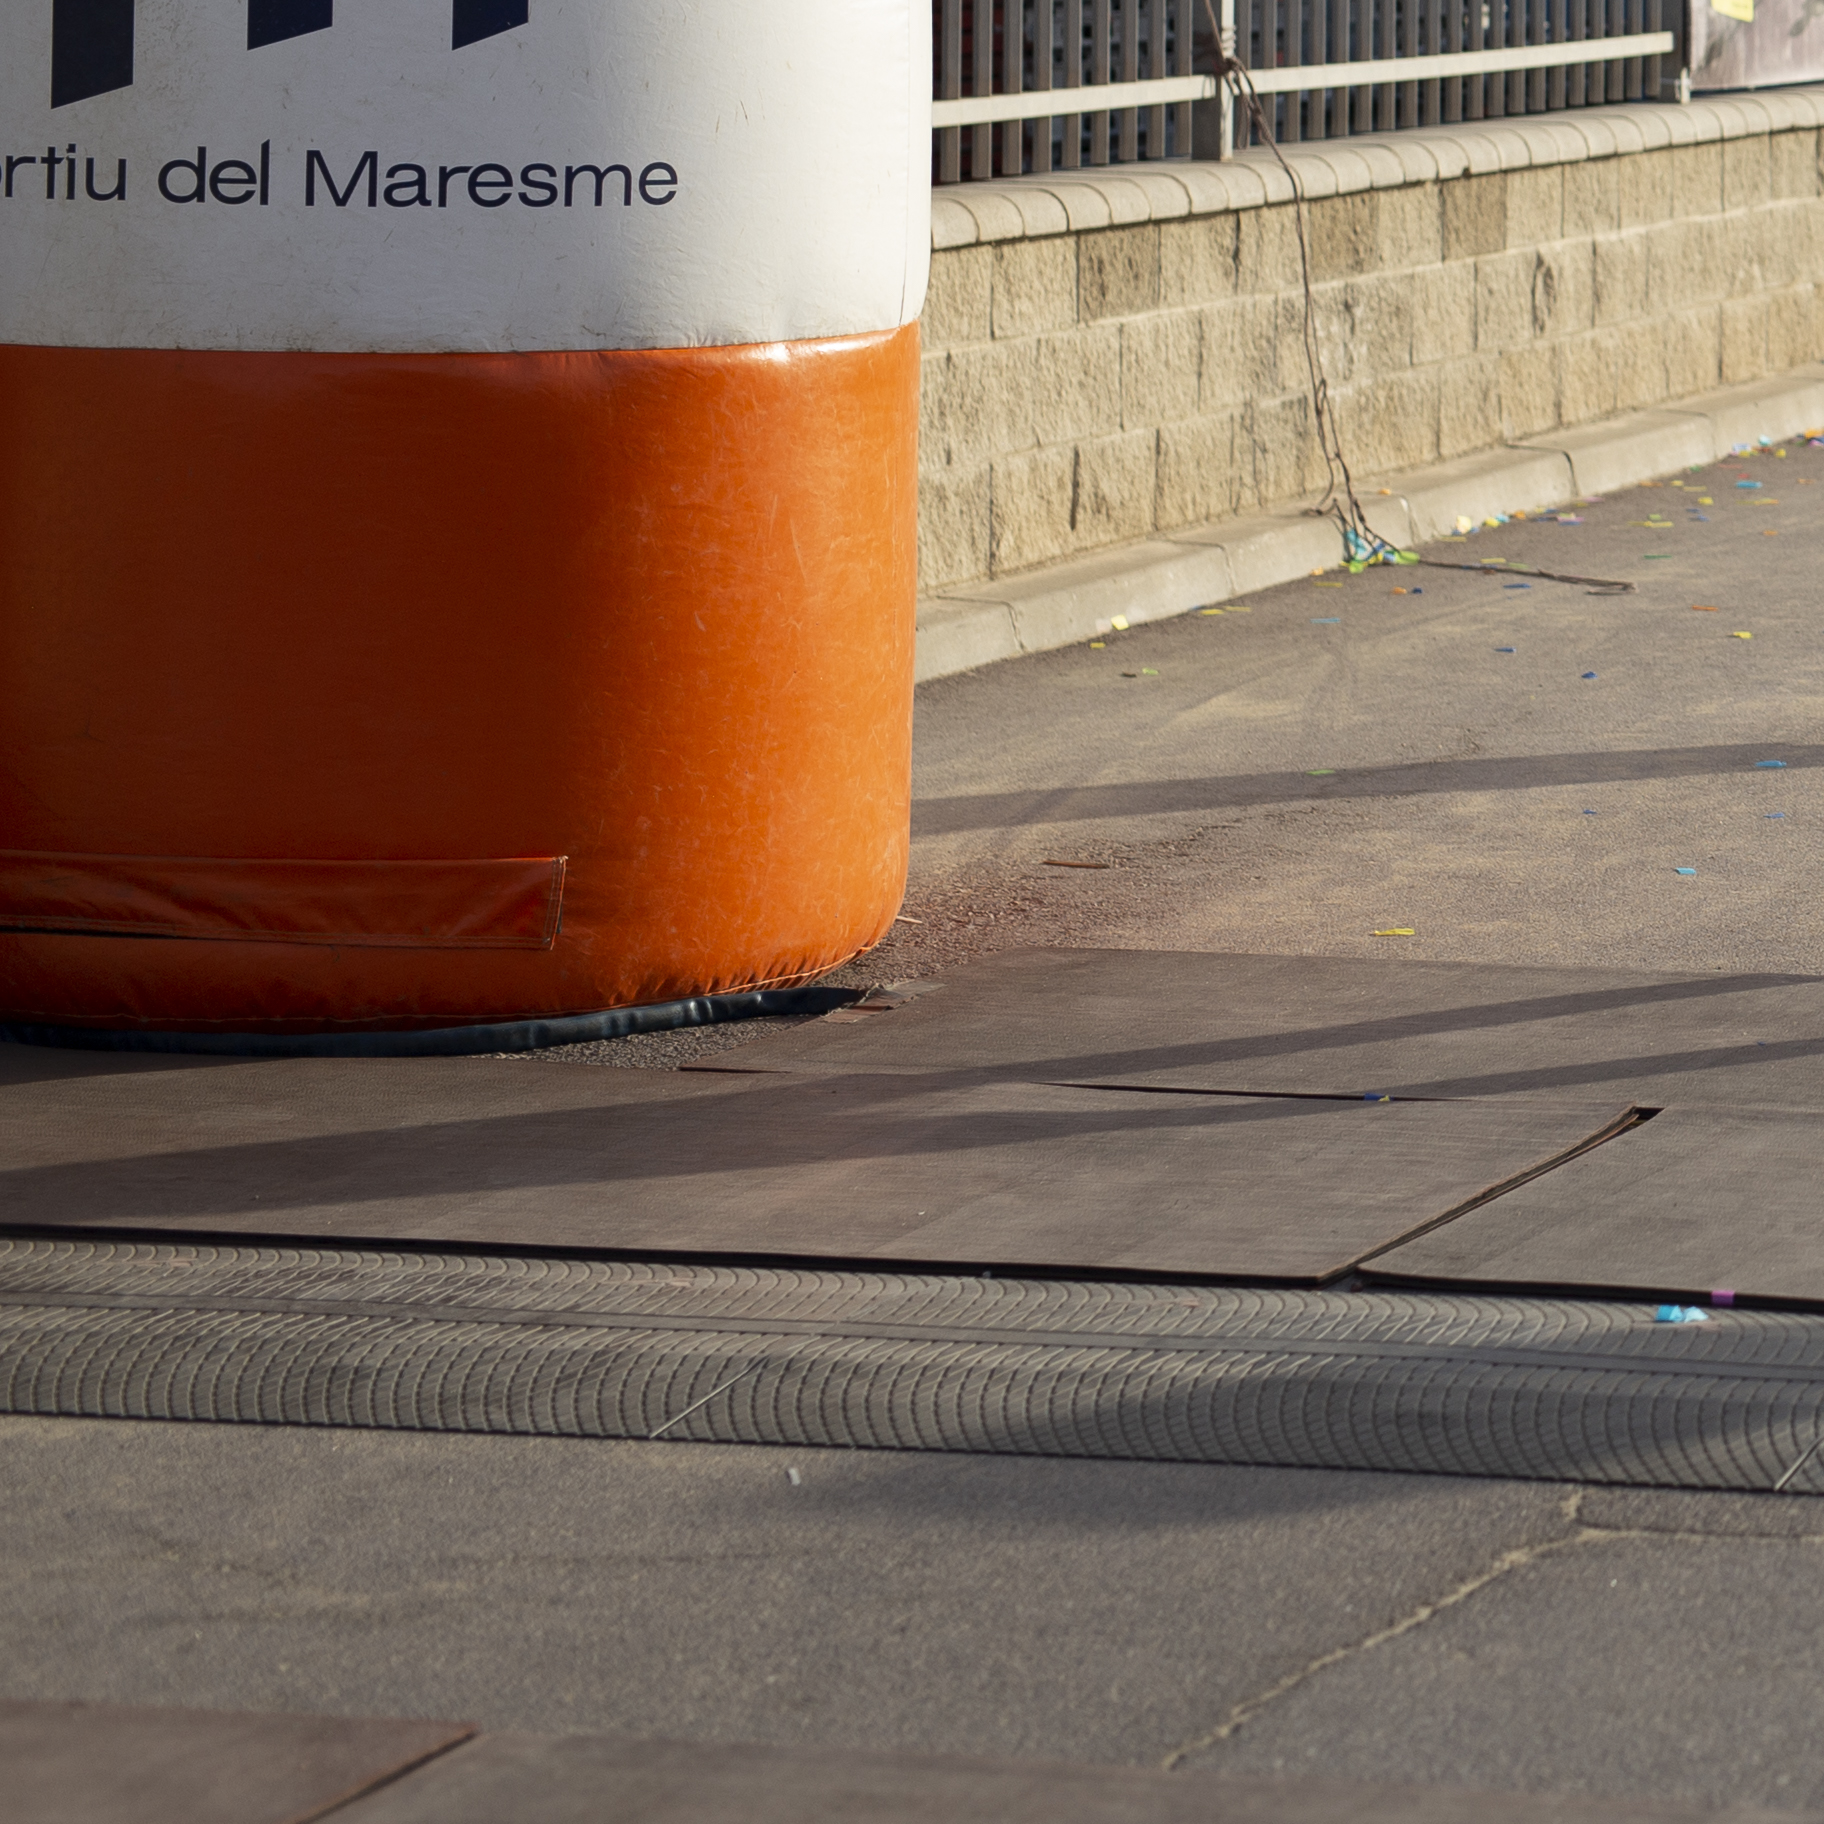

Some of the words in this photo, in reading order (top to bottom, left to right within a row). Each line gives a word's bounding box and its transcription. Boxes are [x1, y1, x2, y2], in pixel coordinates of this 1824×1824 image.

[0, 143, 127, 201] rtiu
[158, 139, 270, 205] del
[305, 150, 679, 207] Maresme
